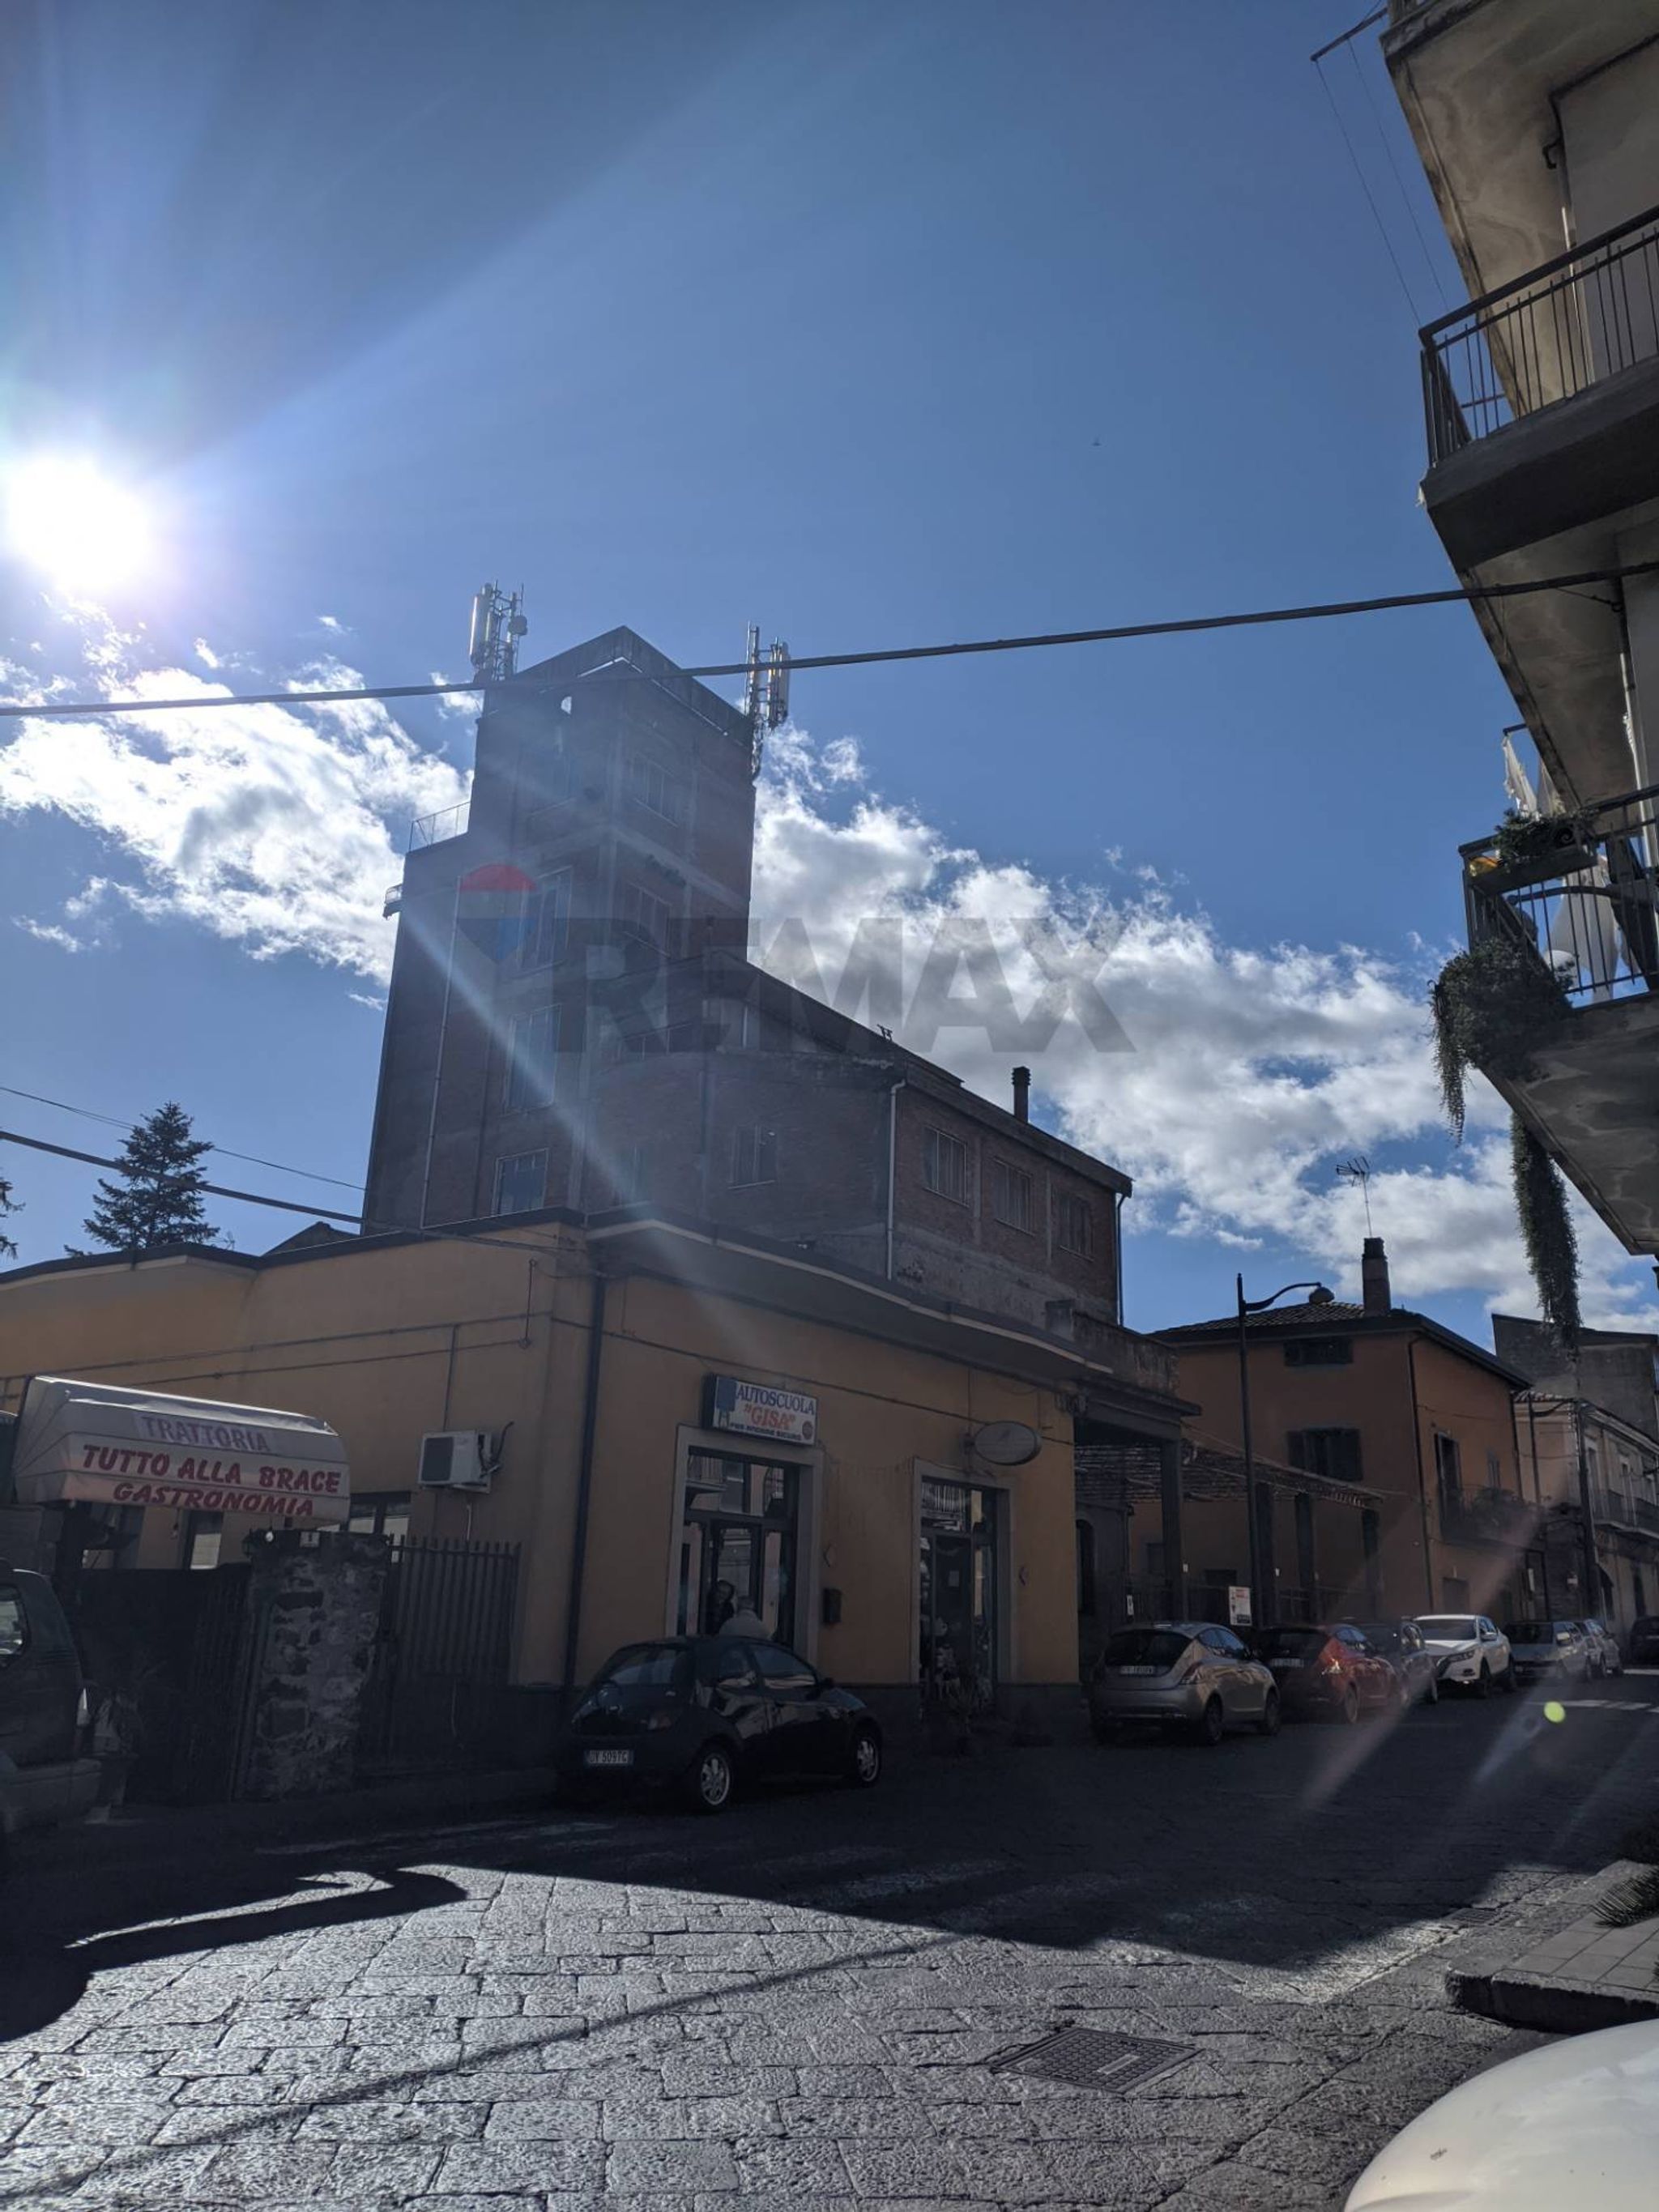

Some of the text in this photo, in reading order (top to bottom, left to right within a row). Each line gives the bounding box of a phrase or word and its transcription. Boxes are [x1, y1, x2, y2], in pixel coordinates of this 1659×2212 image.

[736, 1385, 815, 1415] AUTOSCUOLA
[142, 1416, 271, 1452] TRATTORIA
[83, 1444, 342, 1494] TUTTO ALLA BRACE
[113, 1482, 314, 1517] GASTRONOMIA
